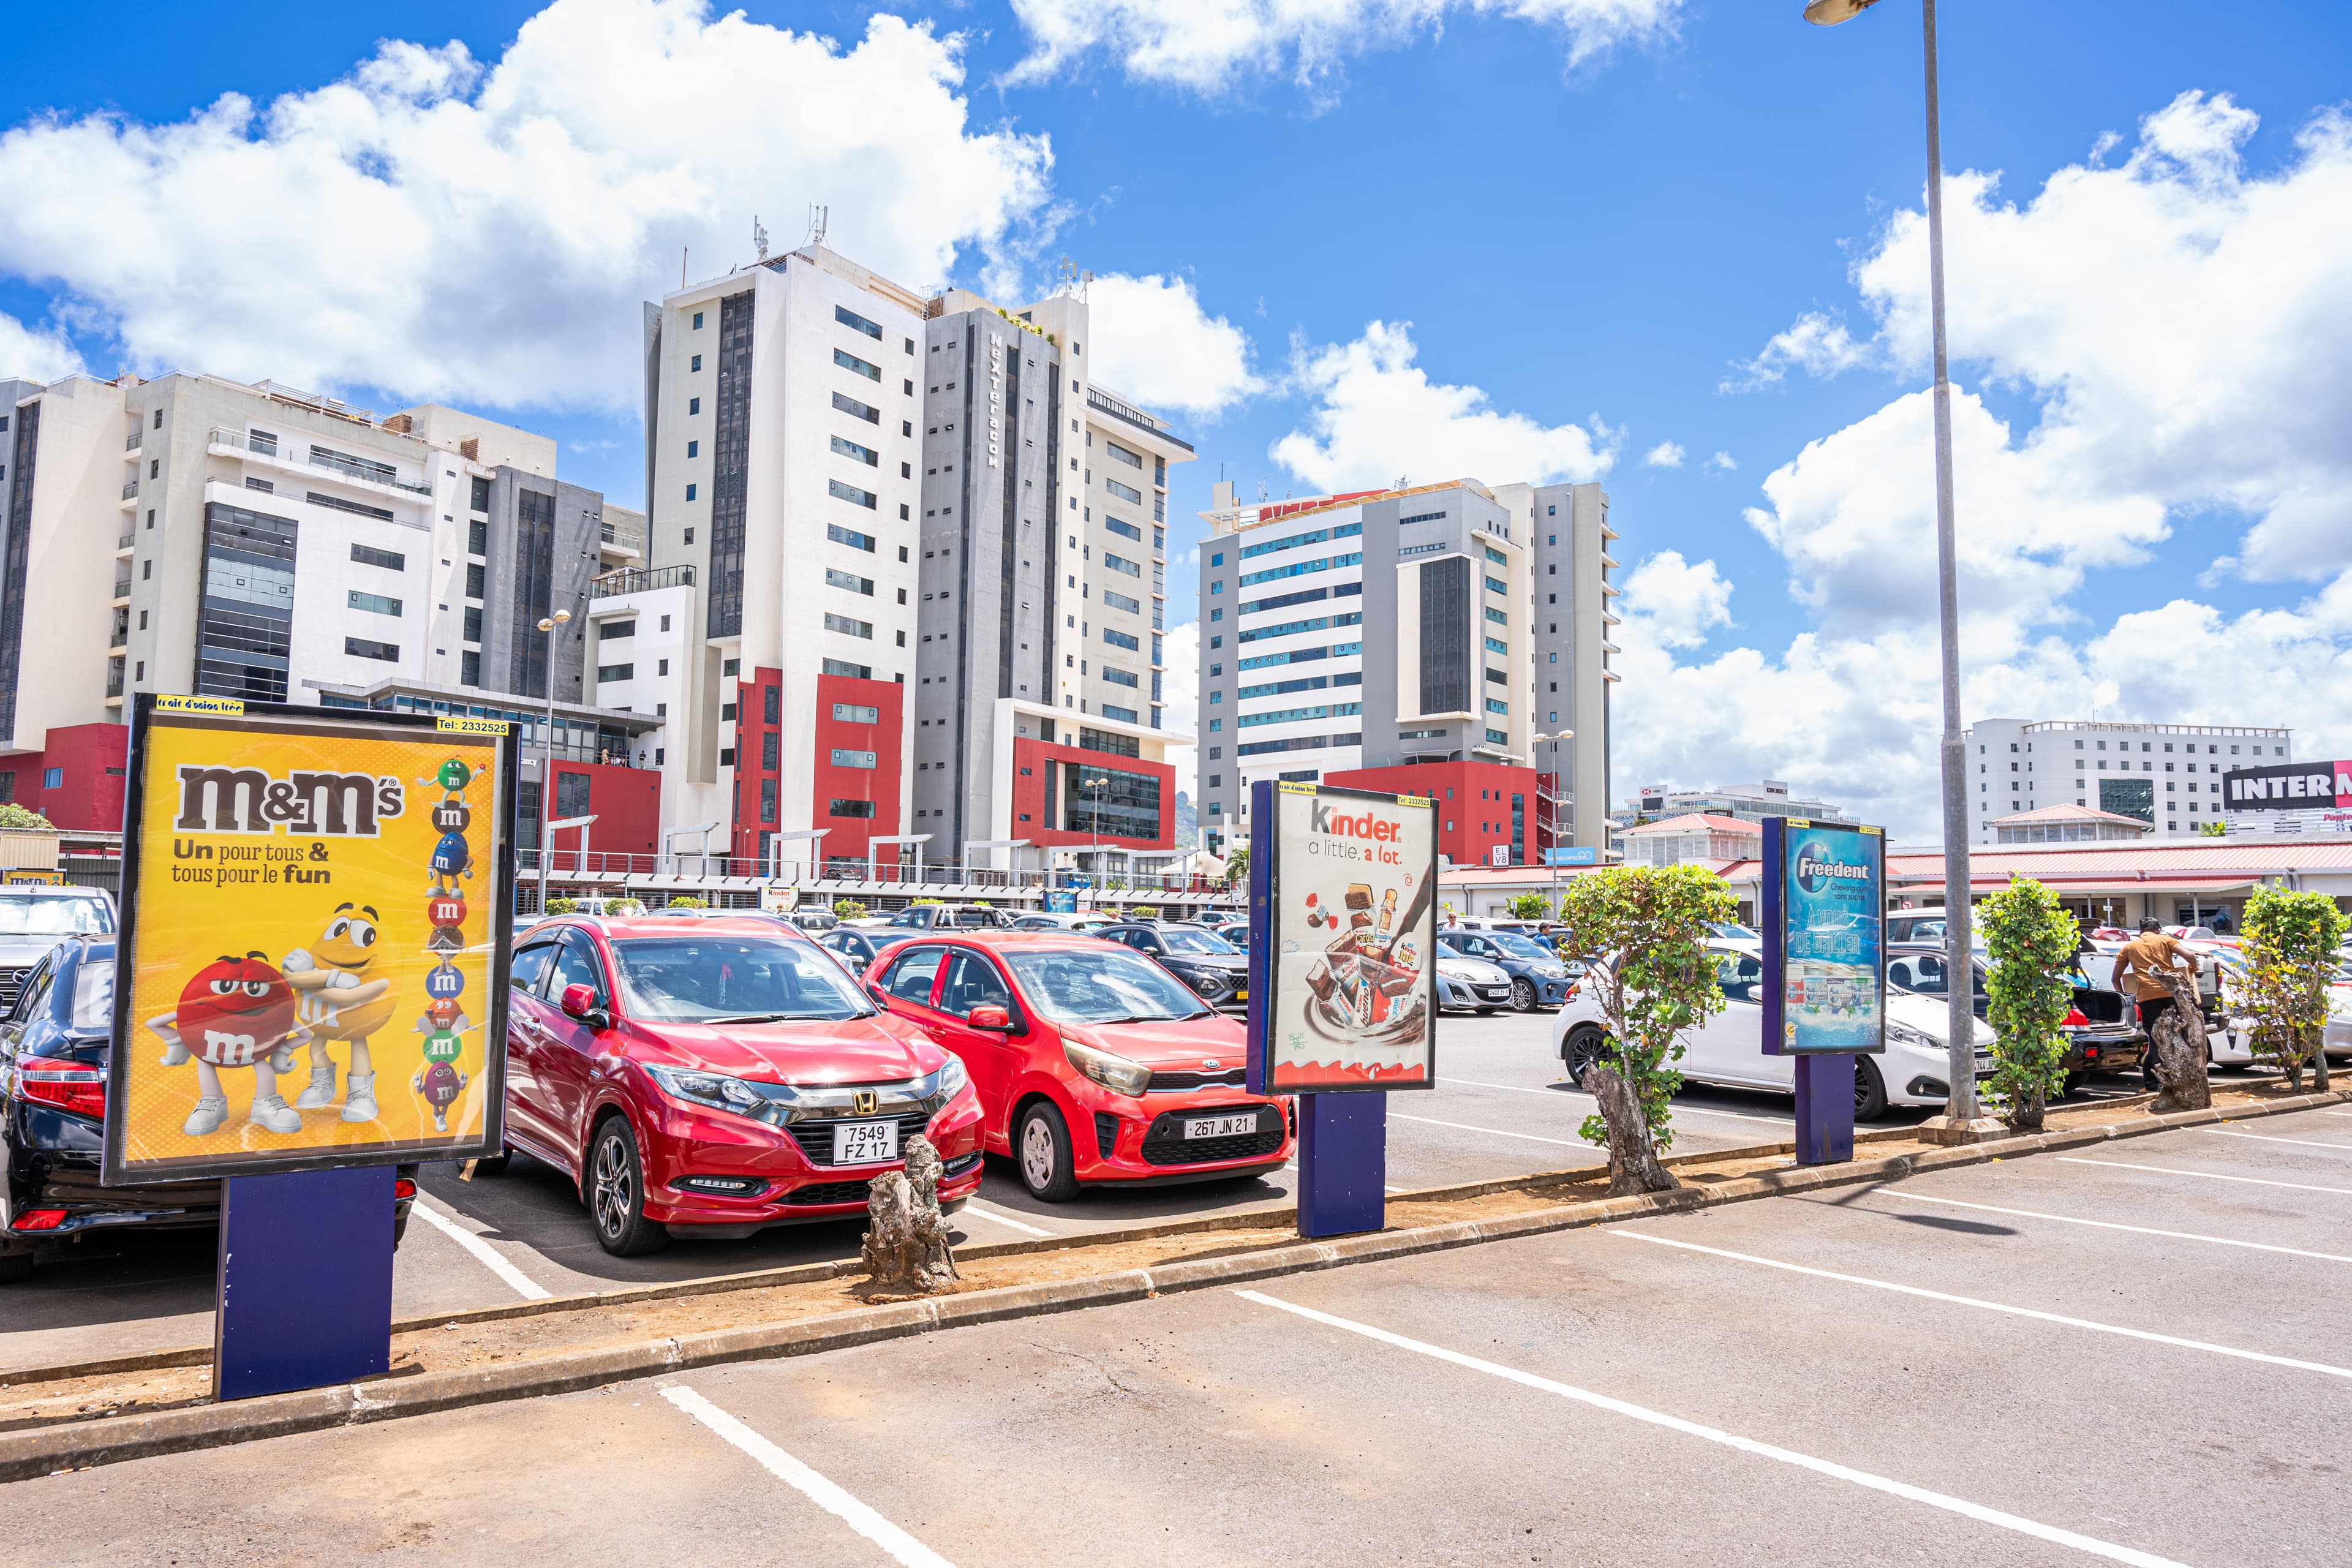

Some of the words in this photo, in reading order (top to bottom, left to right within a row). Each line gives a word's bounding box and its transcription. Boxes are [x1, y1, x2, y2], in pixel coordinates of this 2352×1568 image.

[439, 720, 458, 730] Tel:
[461, 722, 507, 733] 2332525
[174, 839, 213, 859] Un
[219, 846, 261, 865] pour
[265, 844, 304, 861] tous
[309, 842, 329, 862] &
[1309, 842, 1318, 854] a
[1324, 839, 1360, 862] little,
[1364, 848, 1372, 862] a
[172, 864, 213, 882] tous
[216, 868, 259, 888] pour
[262, 864, 277, 883] le
[283, 864, 331, 884] fun
[1800, 858, 1869, 880] Freedent
[1831, 883, 1855, 893] Chewing
[1795, 932, 1811, 953] DE
[202, 1030, 255, 1065] m
[849, 1126, 884, 1142] 7549
[1195, 1121, 1215, 1136] 267
[1219, 1120, 1232, 1134] JN
[1236, 1118, 1247, 1132] 21
[845, 1144, 865, 1158] FZ
[872, 1142, 888, 1156] 17
